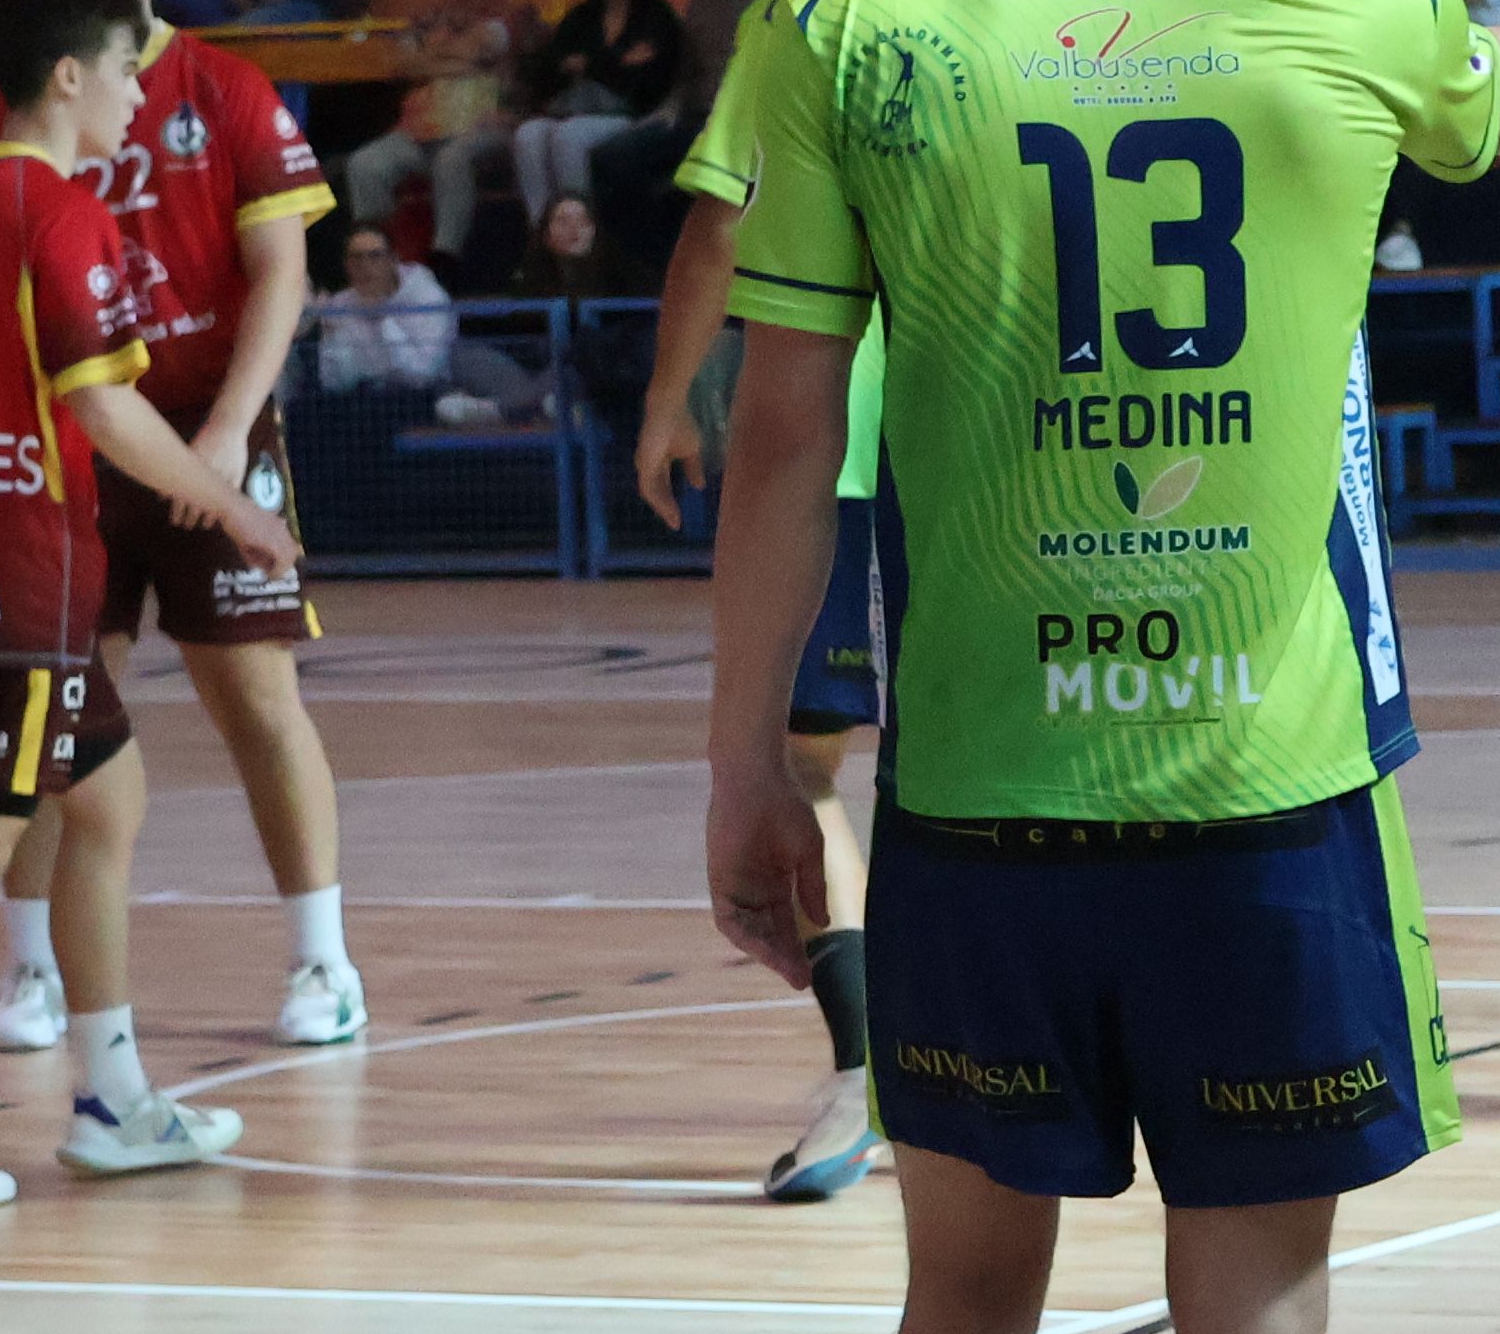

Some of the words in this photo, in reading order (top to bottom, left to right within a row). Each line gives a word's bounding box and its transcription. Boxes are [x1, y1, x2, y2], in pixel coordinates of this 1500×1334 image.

[1010, 45, 1240, 79] Valbusenda
[1016, 118, 1247, 374] 13
[1033, 390, 1252, 451] MEDINA
[1039, 526, 1250, 557] MOLENDUM
[1038, 610, 1180, 663] PRO
[1201, 1058, 1388, 1112] UNIVERSAL
